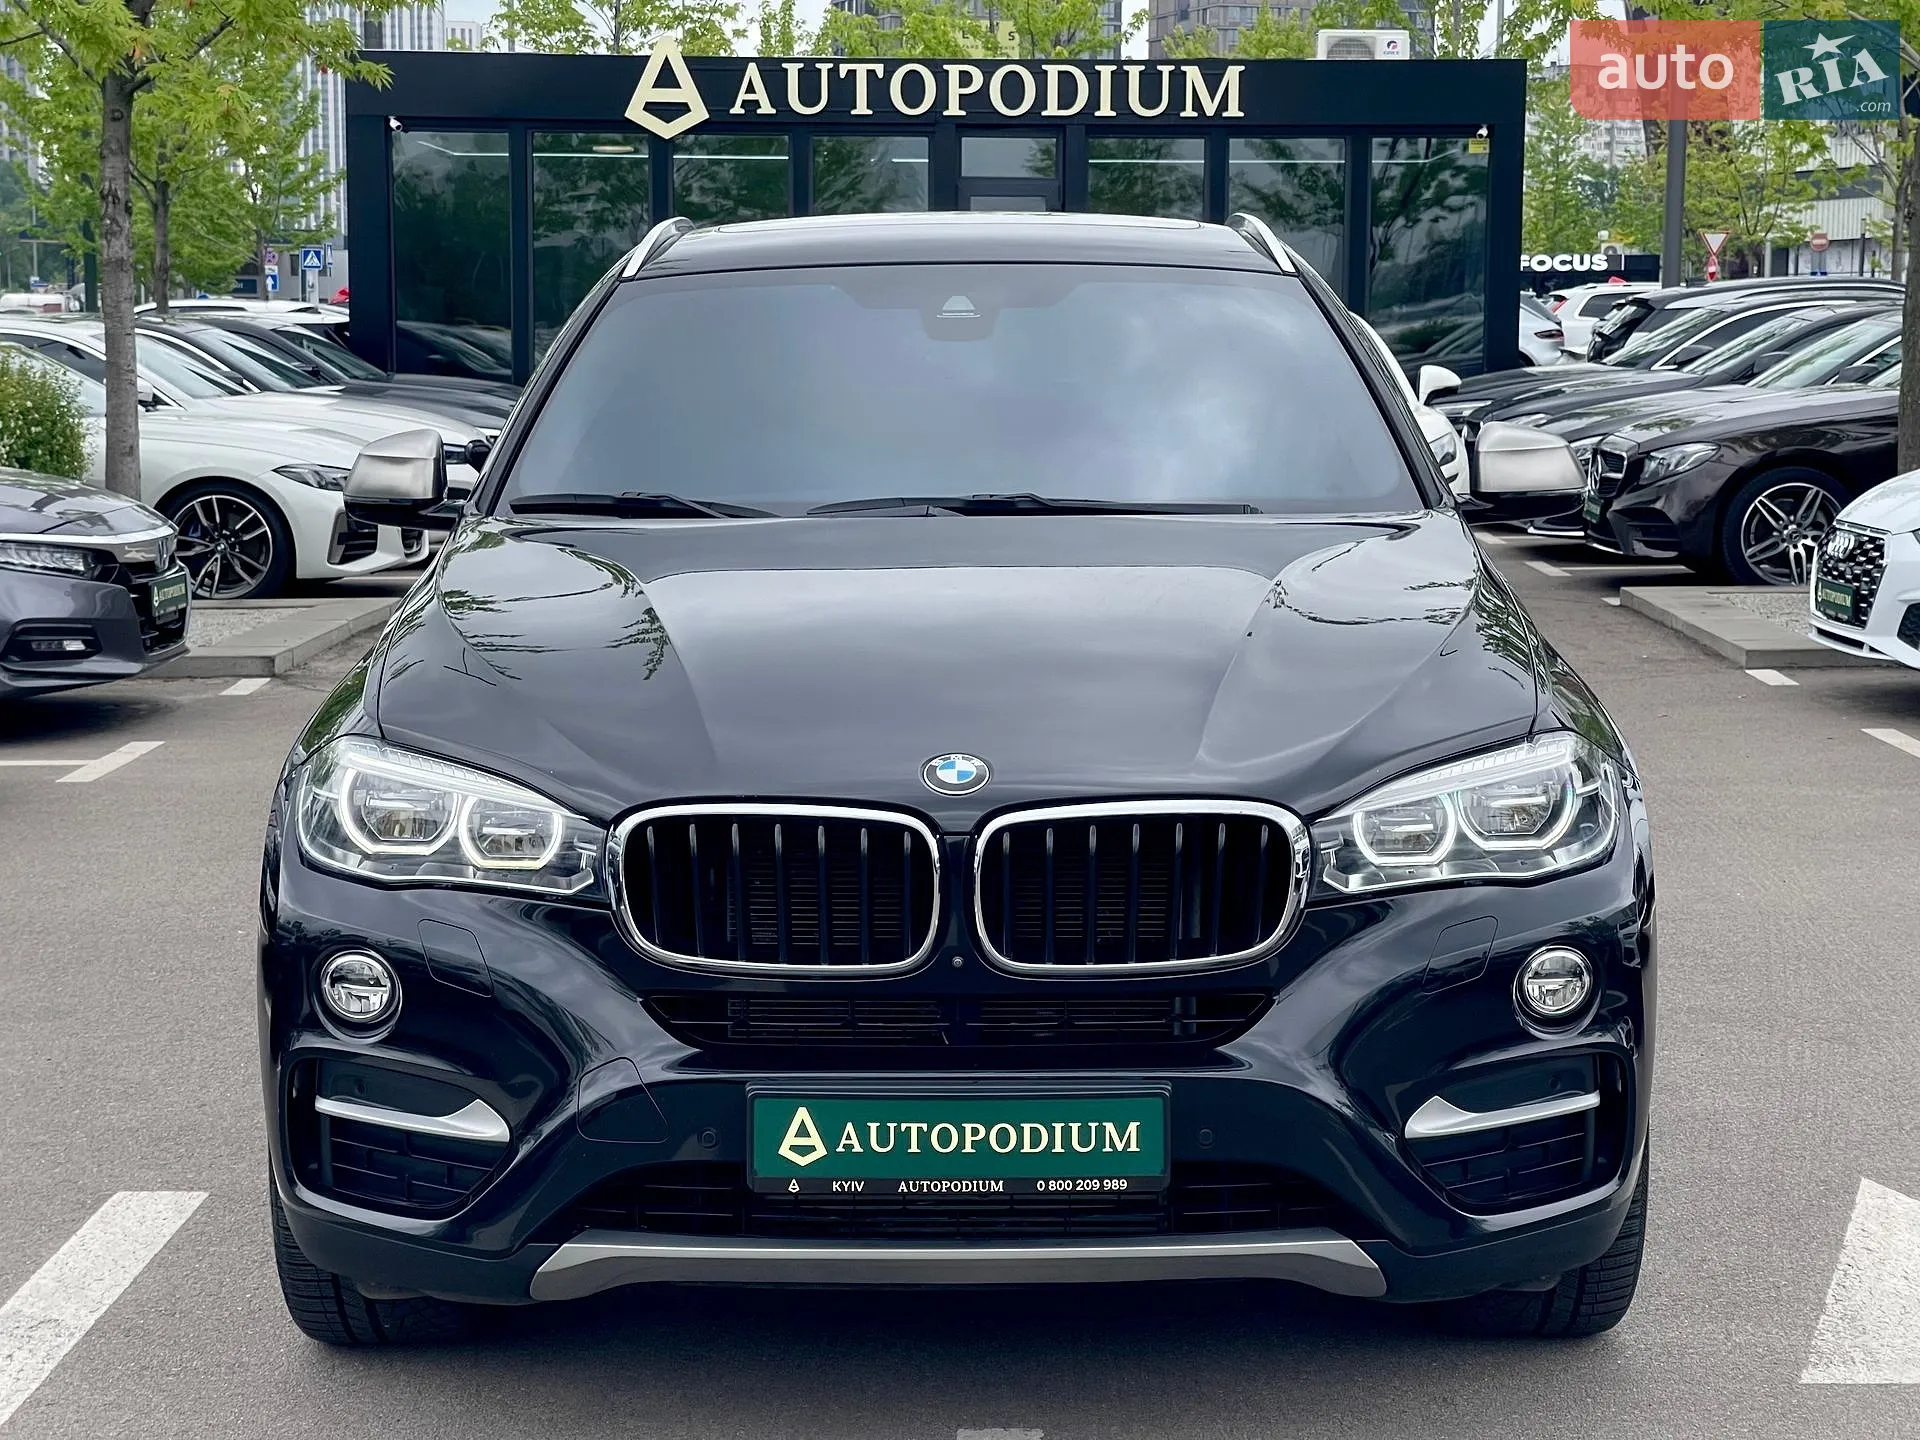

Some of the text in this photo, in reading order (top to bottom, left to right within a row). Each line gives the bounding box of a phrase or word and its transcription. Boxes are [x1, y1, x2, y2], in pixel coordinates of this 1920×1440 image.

[729, 62, 1246, 118] AUTOPODIUM
[1520, 253, 1609, 272] FOCUS
[835, 1121, 1141, 1154] AUTOPODIUM
[832, 1178, 1128, 1194] KYIV AUTOPODIUM 0 800 209 989
